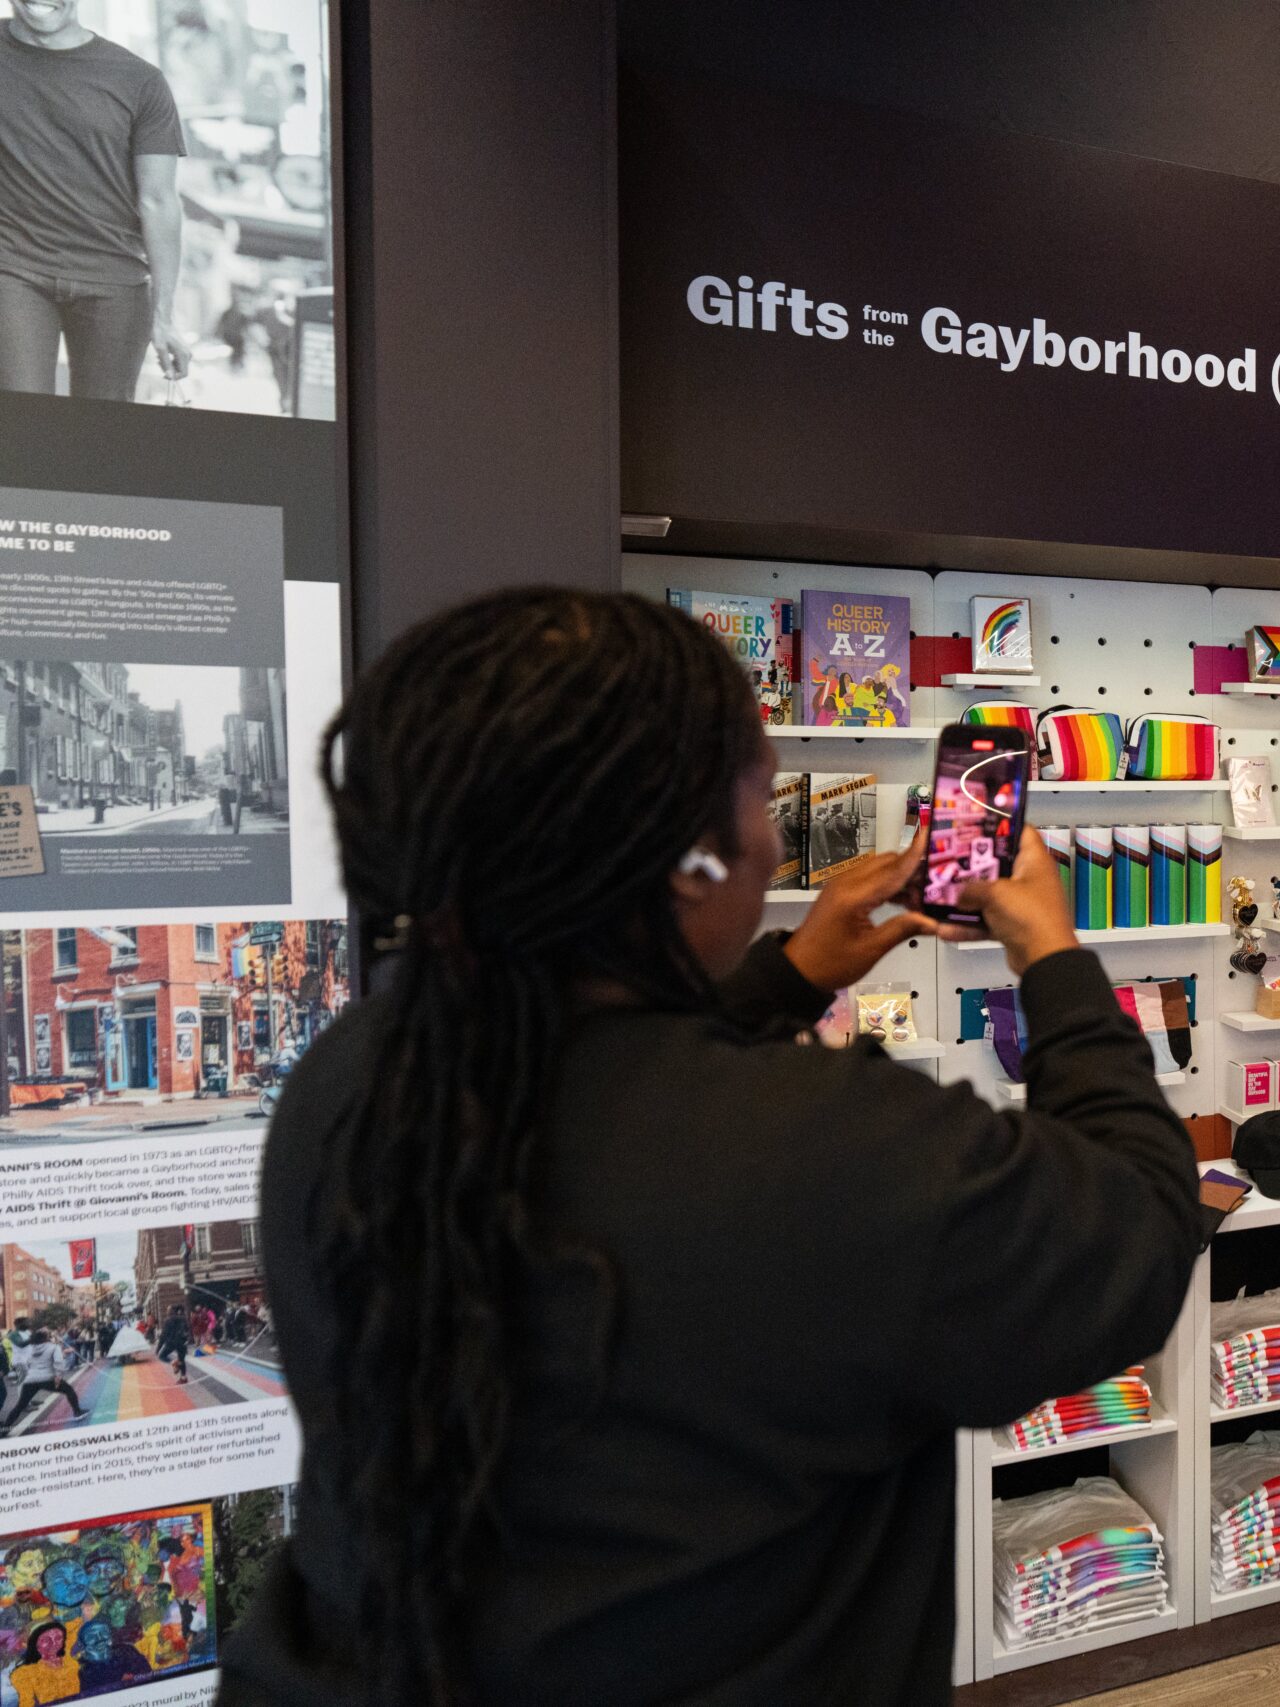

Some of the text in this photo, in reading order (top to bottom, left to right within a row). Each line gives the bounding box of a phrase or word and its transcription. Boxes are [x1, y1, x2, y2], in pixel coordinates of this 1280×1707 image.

[687, 276, 849, 340] Gifts
[862, 304, 909, 326] from
[862, 328, 895, 347] the
[921, 306, 1256, 392] Gayborhood
[18, 520, 51, 534] THE
[54, 523, 172, 541] GAYBORHOOD
[27, 538, 50, 550] TO
[54, 540, 75, 552] BE
[832, 604, 884, 620] QUEER
[703, 612, 766, 638] QUEER
[826, 618, 890, 634] HISTORY
[830, 633, 886, 658] A to Z
[777, 786, 792, 798] ARK
[821, 783, 844, 800] MARK
[846, 779, 868, 791] SEGAL
[30, 1175, 51, 1184] and
[53, 1169, 93, 1183] quickly
[95, 1168, 139, 1178] became
[151, 1160, 216, 1173] Gayborhood
[219, 1158, 256, 1167] anchor.
[44, 1158, 83, 1169] ROOM
[86, 1154, 127, 1167] opened
[143, 1151, 168, 1160] 1973
[170, 1151, 182, 1159] as
[6, 1190, 187, 1214] AIDS Thrift @ Giovanni's Room.
[44, 1432, 130, 1452] CROSSWALKS
[132, 1430, 142, 1438] at
[147, 1426, 170, 1436] 12th
[172, 1421, 192, 1431] and
[195, 1418, 218, 1429] 13th
[221, 1412, 258, 1424] Streets
[260, 1408, 288, 1418] along
[18, 1458, 52, 1470] honor
[55, 1454, 74, 1464] the
[76, 1440, 152, 1460] Gayborhood's
[156, 1436, 183, 1449] spirit
[185, 1434, 196, 1443] of
[199, 1428, 242, 1440] activism
[245, 1422, 264, 1433] and
[40, 1464, 88, 1479] Installed
[104, 1457, 134, 1469] 2015,
[137, 1452, 160, 1463] they
[163, 1449, 188, 1459] were
[191, 1444, 213, 1454] later
